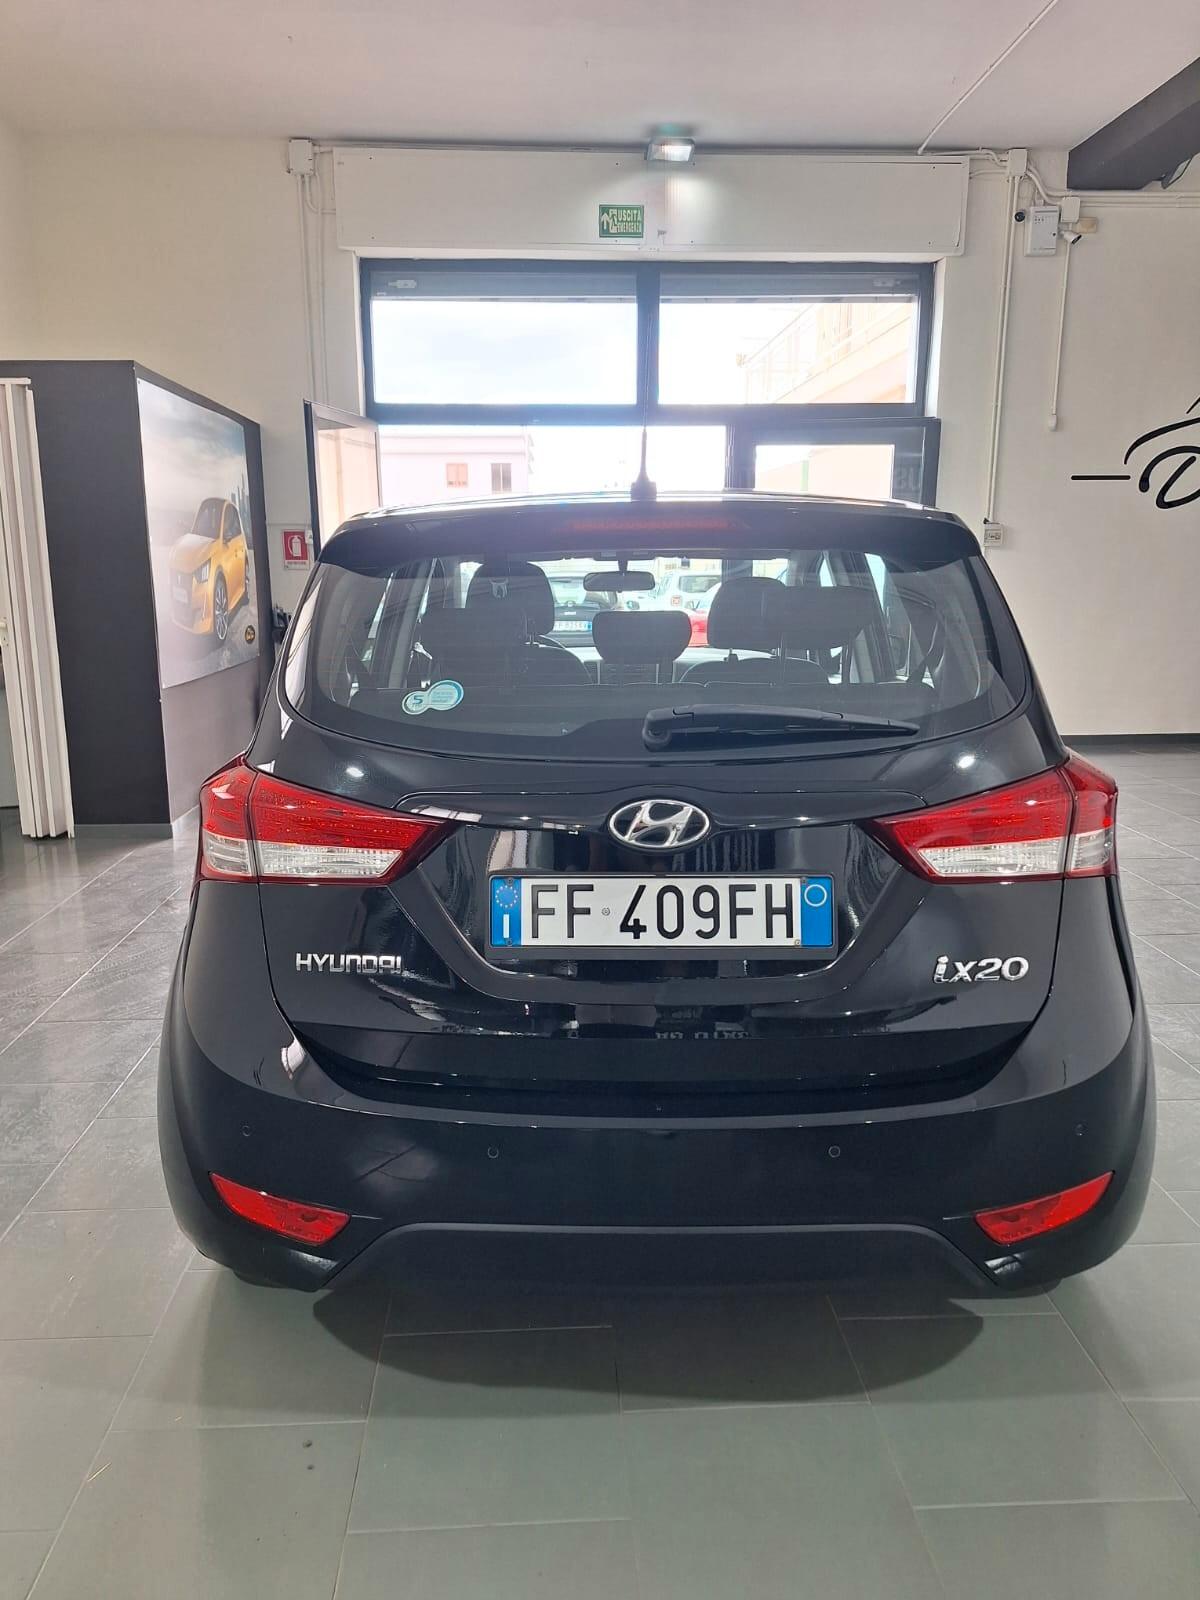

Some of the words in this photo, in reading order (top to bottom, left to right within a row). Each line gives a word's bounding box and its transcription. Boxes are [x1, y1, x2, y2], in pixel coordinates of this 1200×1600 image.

[618, 210, 641, 221] USCITA
[531, 883, 594, 940] FF
[619, 883, 794, 940] 409FH
[295, 952, 402, 974] HYUNDAI
[933, 955, 1029, 984] ix20
